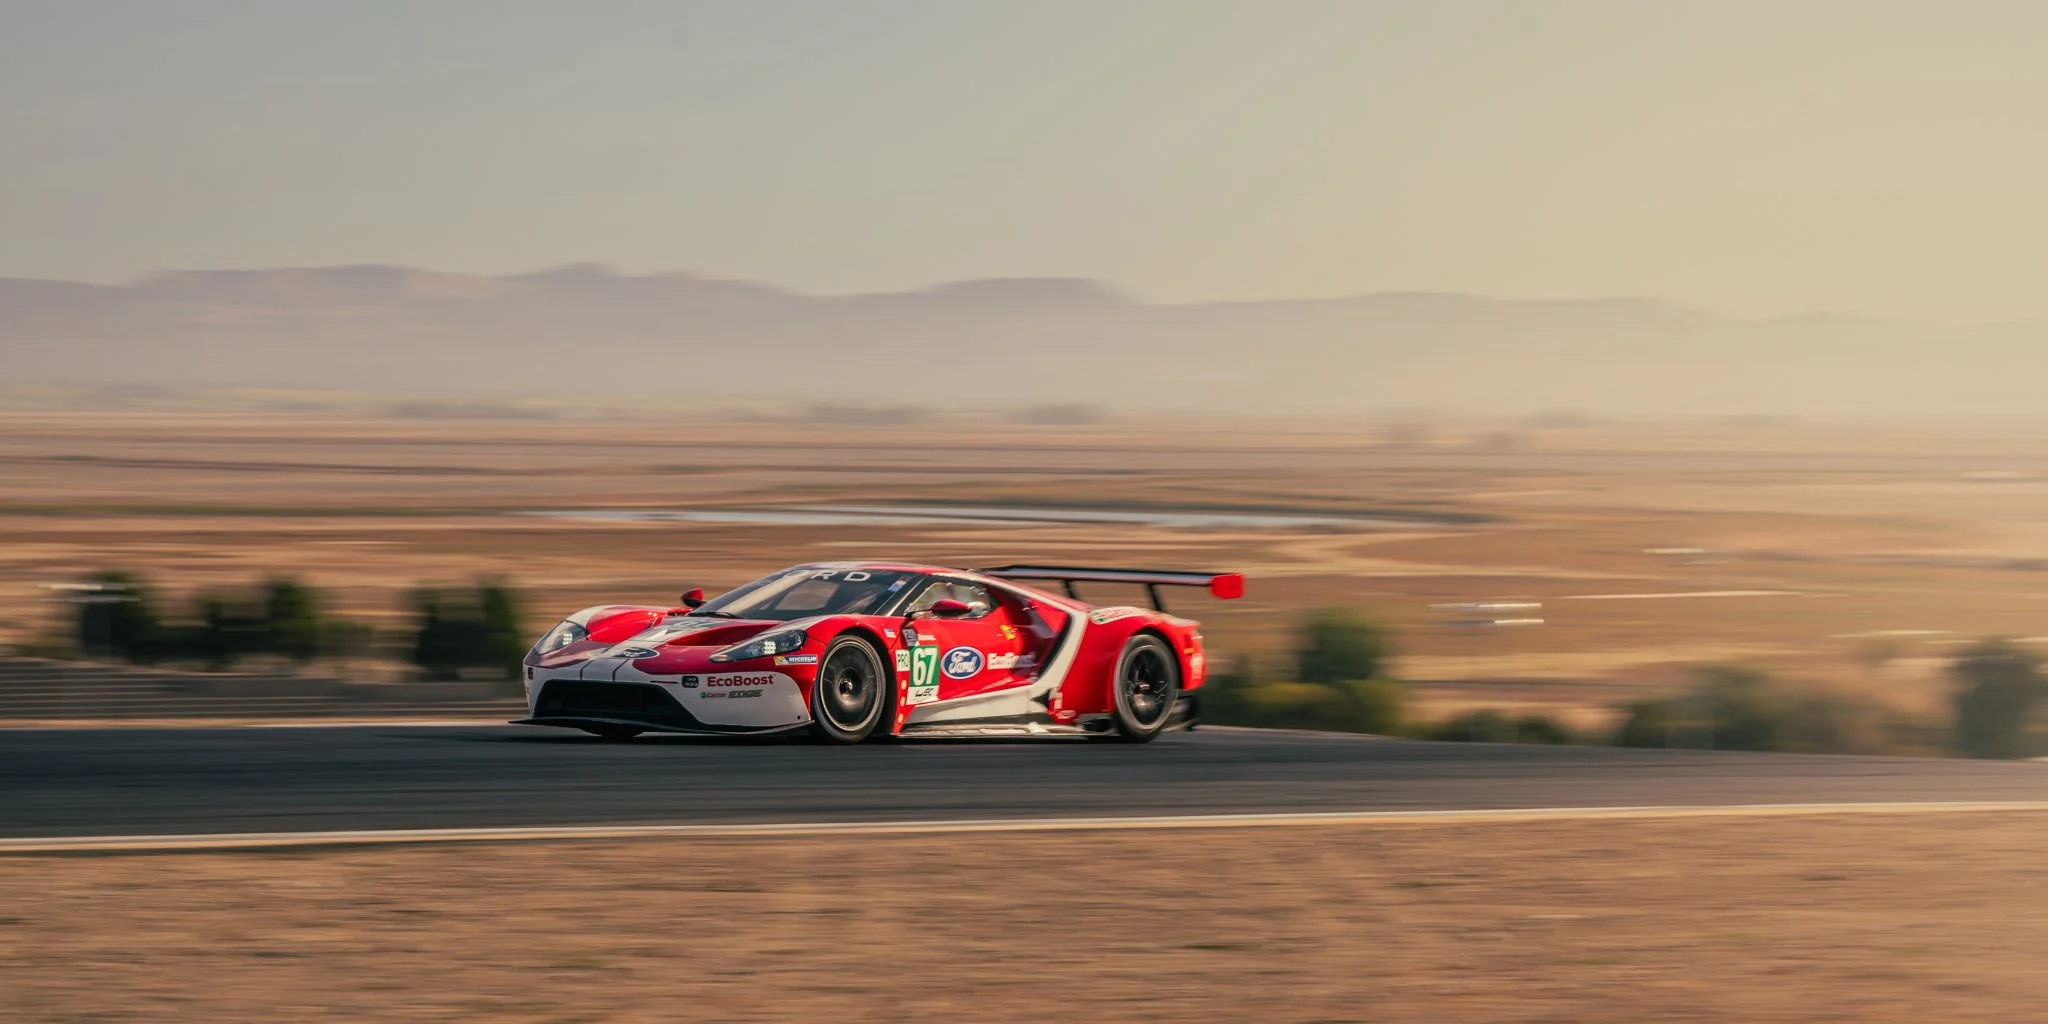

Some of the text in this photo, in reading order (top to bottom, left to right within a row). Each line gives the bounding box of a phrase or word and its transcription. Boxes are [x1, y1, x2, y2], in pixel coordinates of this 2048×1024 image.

[913, 647, 938, 686] 67
[948, 651, 978, 675] Ford
[707, 674, 774, 687] EcoBoost
